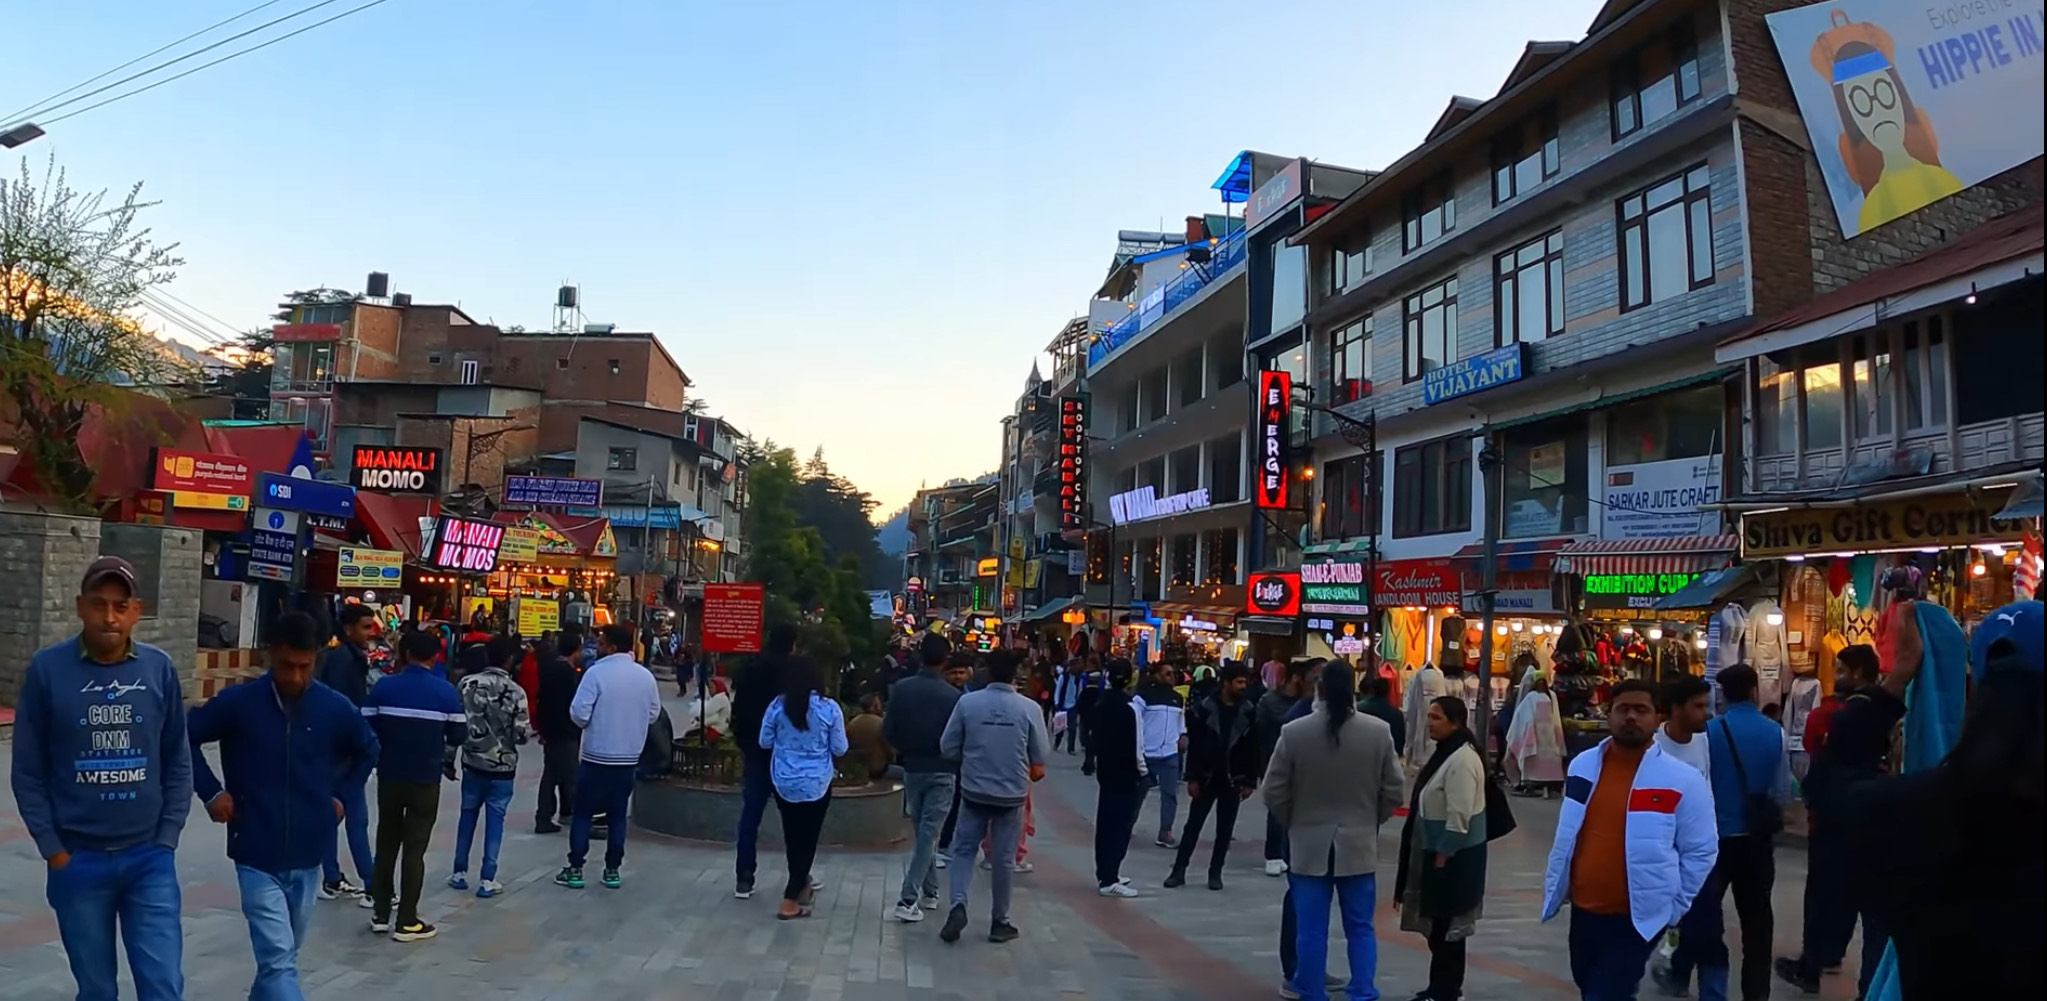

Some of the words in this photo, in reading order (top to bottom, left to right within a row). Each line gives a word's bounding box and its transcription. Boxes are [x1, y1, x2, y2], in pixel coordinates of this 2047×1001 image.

[1918, 24, 2012, 89] HIPPIE
[2007, 14, 2043, 58] IN
[1427, 358, 1518, 401] VIJAYANT
[1428, 361, 1473, 384] HOTEL
[1075, 402, 1083, 476] ROOFTOP
[1266, 388, 1280, 490] EMERGE
[356, 449, 435, 471] MANALI
[361, 469, 425, 489] MOMO
[1061, 444, 1076, 524] MANALI
[277, 484, 292, 499] SBI
[1608, 490, 1650, 511] SARKAR
[1650, 489, 1678, 509] JUTE
[1680, 486, 1719, 506] CRAFT
[1074, 483, 1082, 524] CAFE
[444, 519, 503, 549] MANALI
[1747, 518, 1822, 549] Shiva
[1832, 508, 1893, 545] Gift
[251, 548, 267, 559] STATE
[267, 550, 282, 561] BANK
[282, 553, 293, 563] ATM
[1301, 563, 1363, 583] SHAN-E-PUNJAB
[1381, 568, 1442, 591] Kashmir
[1585, 574, 1656, 594] EXHIBITION
[1425, 592, 1459, 605] HOUSE
[88, 704, 133, 725] CORE
[92, 730, 130, 751] DNM
[75, 768, 147, 784] AWESOME
[100, 791, 136, 801] TOWN
